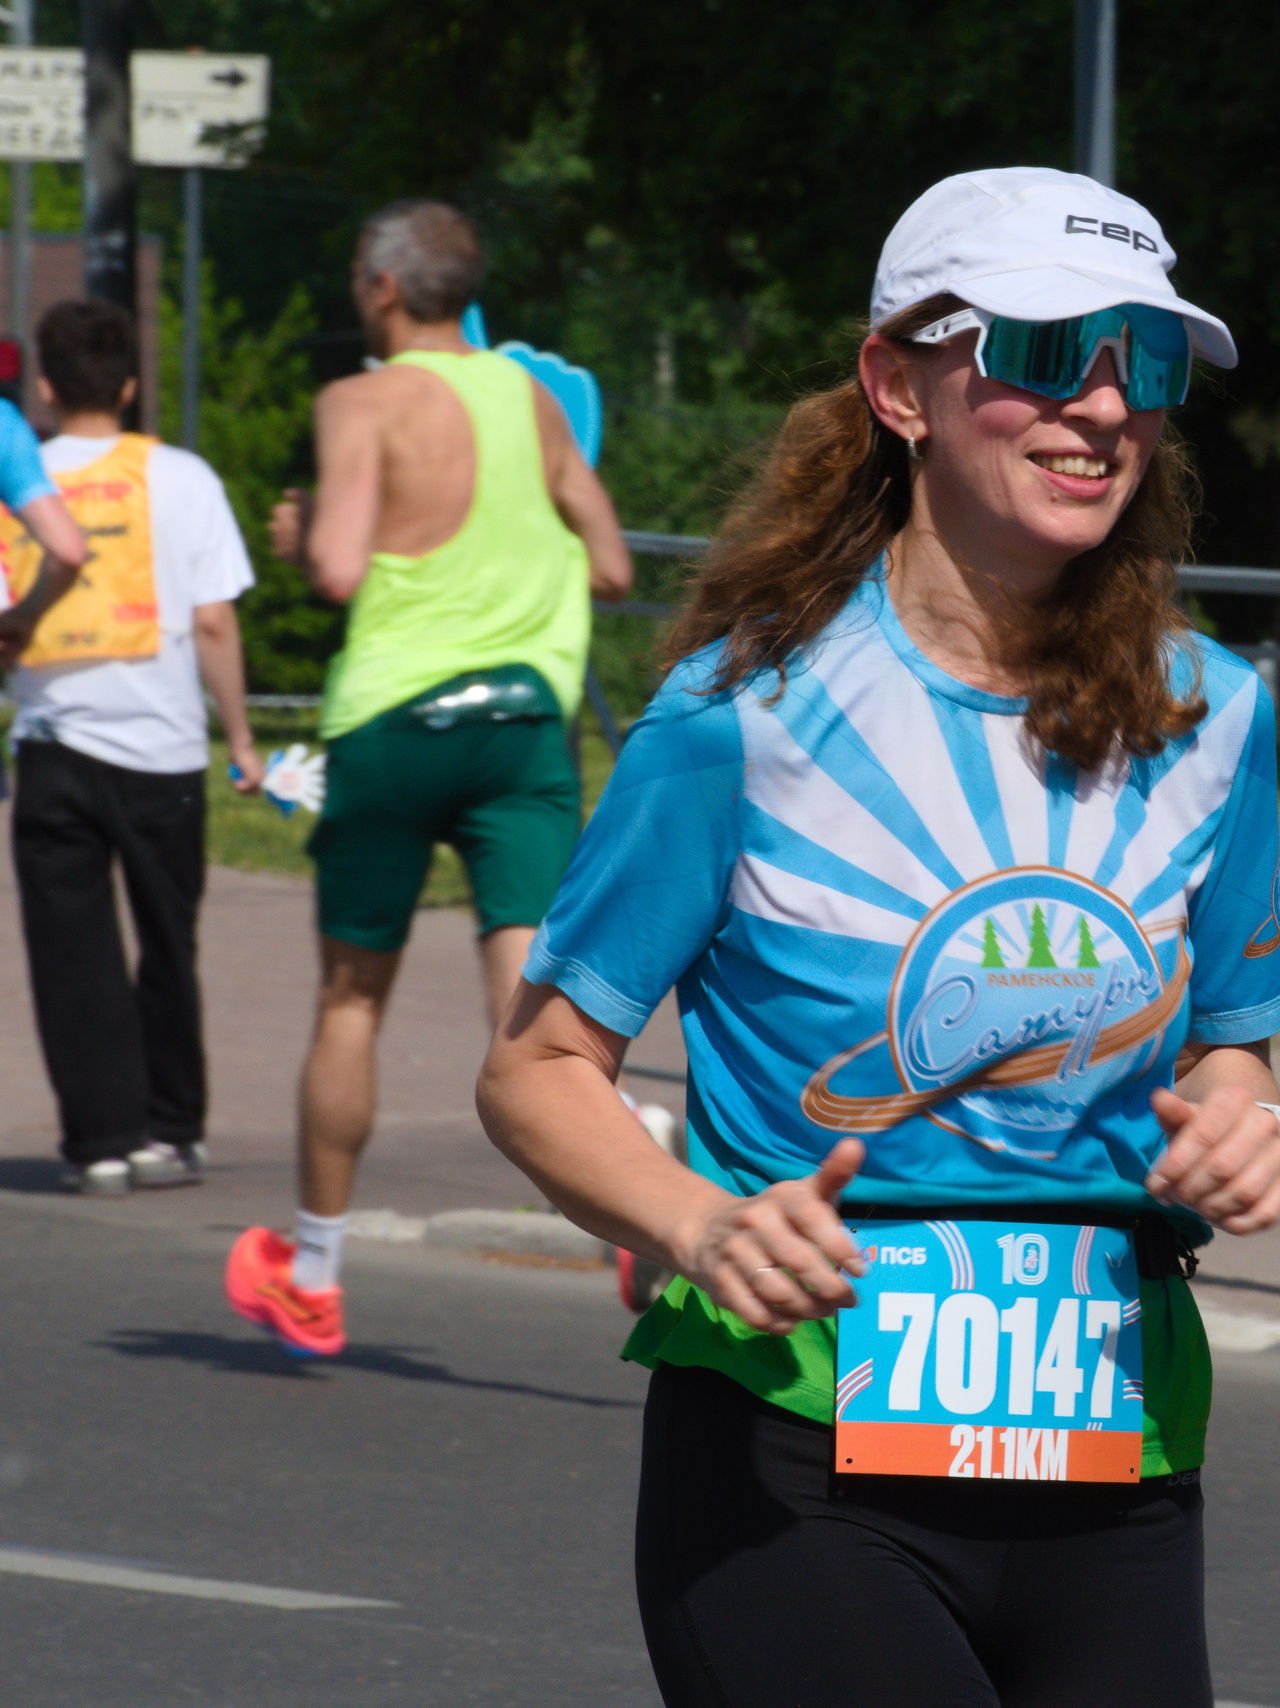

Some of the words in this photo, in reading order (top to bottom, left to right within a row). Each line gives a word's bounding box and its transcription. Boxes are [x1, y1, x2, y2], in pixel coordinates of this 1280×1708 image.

[1065, 214, 1160, 254] cep
[987, 972, 1096, 988] РАМЕНСКОЕ
[881, 1246, 927, 1265] ПСБ
[996, 1233, 1050, 1285] 10
[878, 1292, 1121, 1418] 70147
